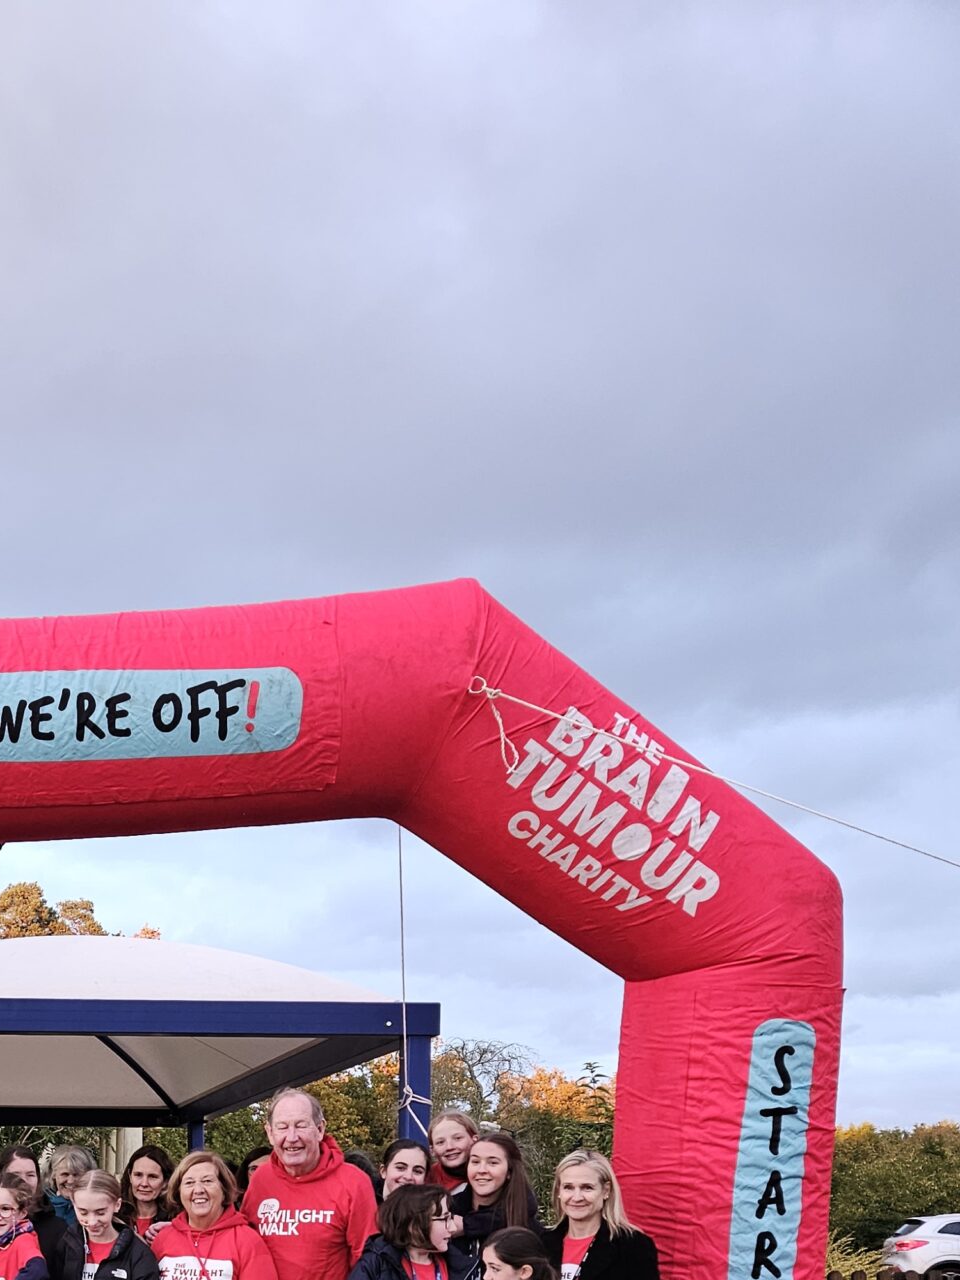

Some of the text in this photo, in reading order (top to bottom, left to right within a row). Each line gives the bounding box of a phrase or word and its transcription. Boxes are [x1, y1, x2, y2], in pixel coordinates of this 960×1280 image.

[152, 678, 260, 742] OFF!
[611, 711, 665, 765] THE
[546, 705, 720, 852] BRAIN
[506, 737, 721, 917] TUMOUR
[507, 810, 652, 912] CHARITY
[258, 1222, 299, 1236] WALK
[260, 1209, 335, 1223] TWILIGHT
[173, 1268, 224, 1277] TWILHT
